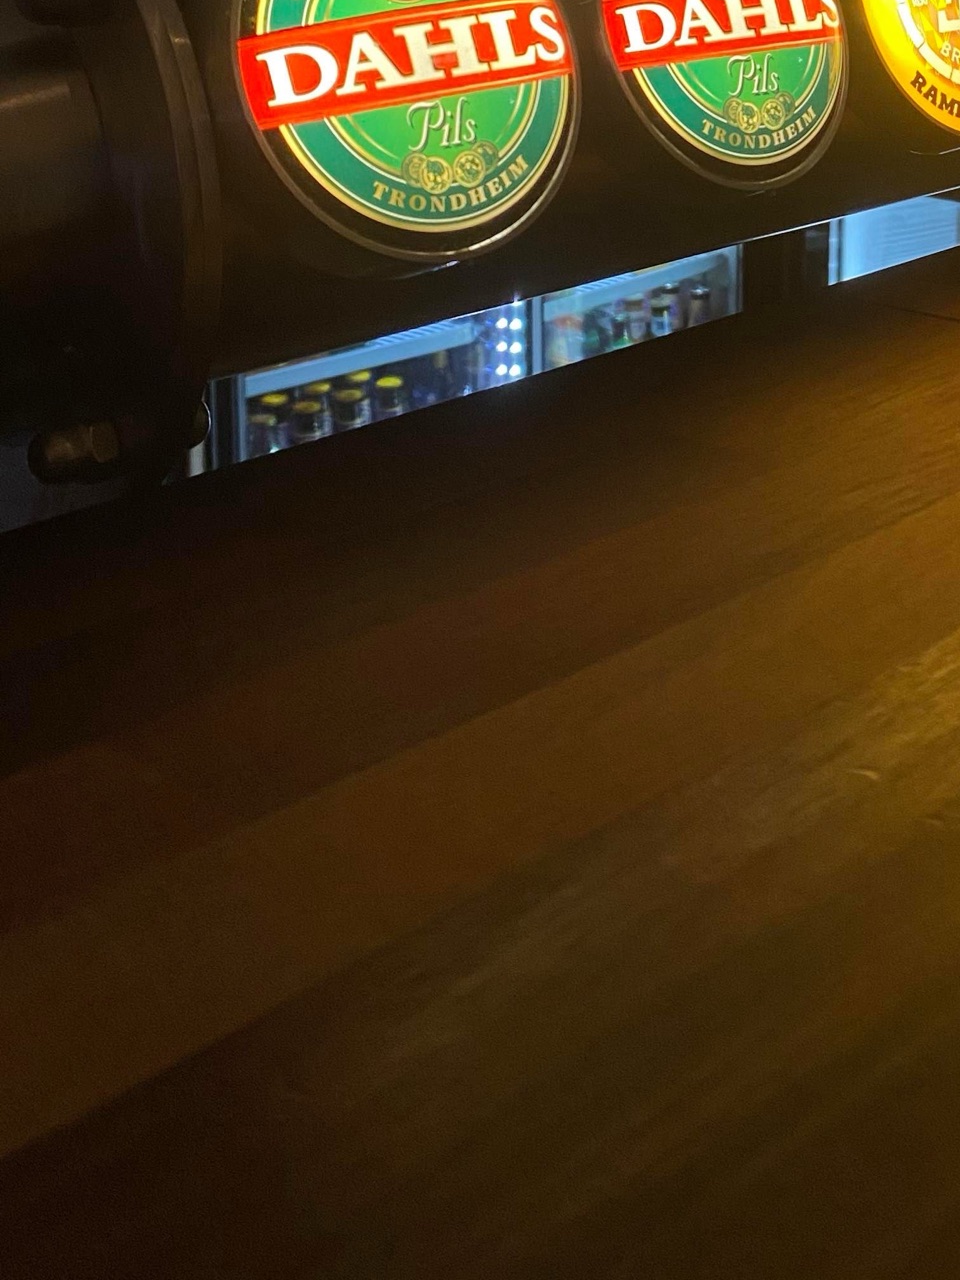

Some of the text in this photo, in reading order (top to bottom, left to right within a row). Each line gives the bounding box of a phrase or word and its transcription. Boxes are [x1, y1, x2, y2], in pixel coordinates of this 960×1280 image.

[256, 5, 566, 108] DAHLS
[727, 53, 781, 96] Pils
[406, 97, 478, 151] Pils
[702, 106, 818, 149] TRONDHEIM
[372, 155, 531, 213] TRONDHEIM
